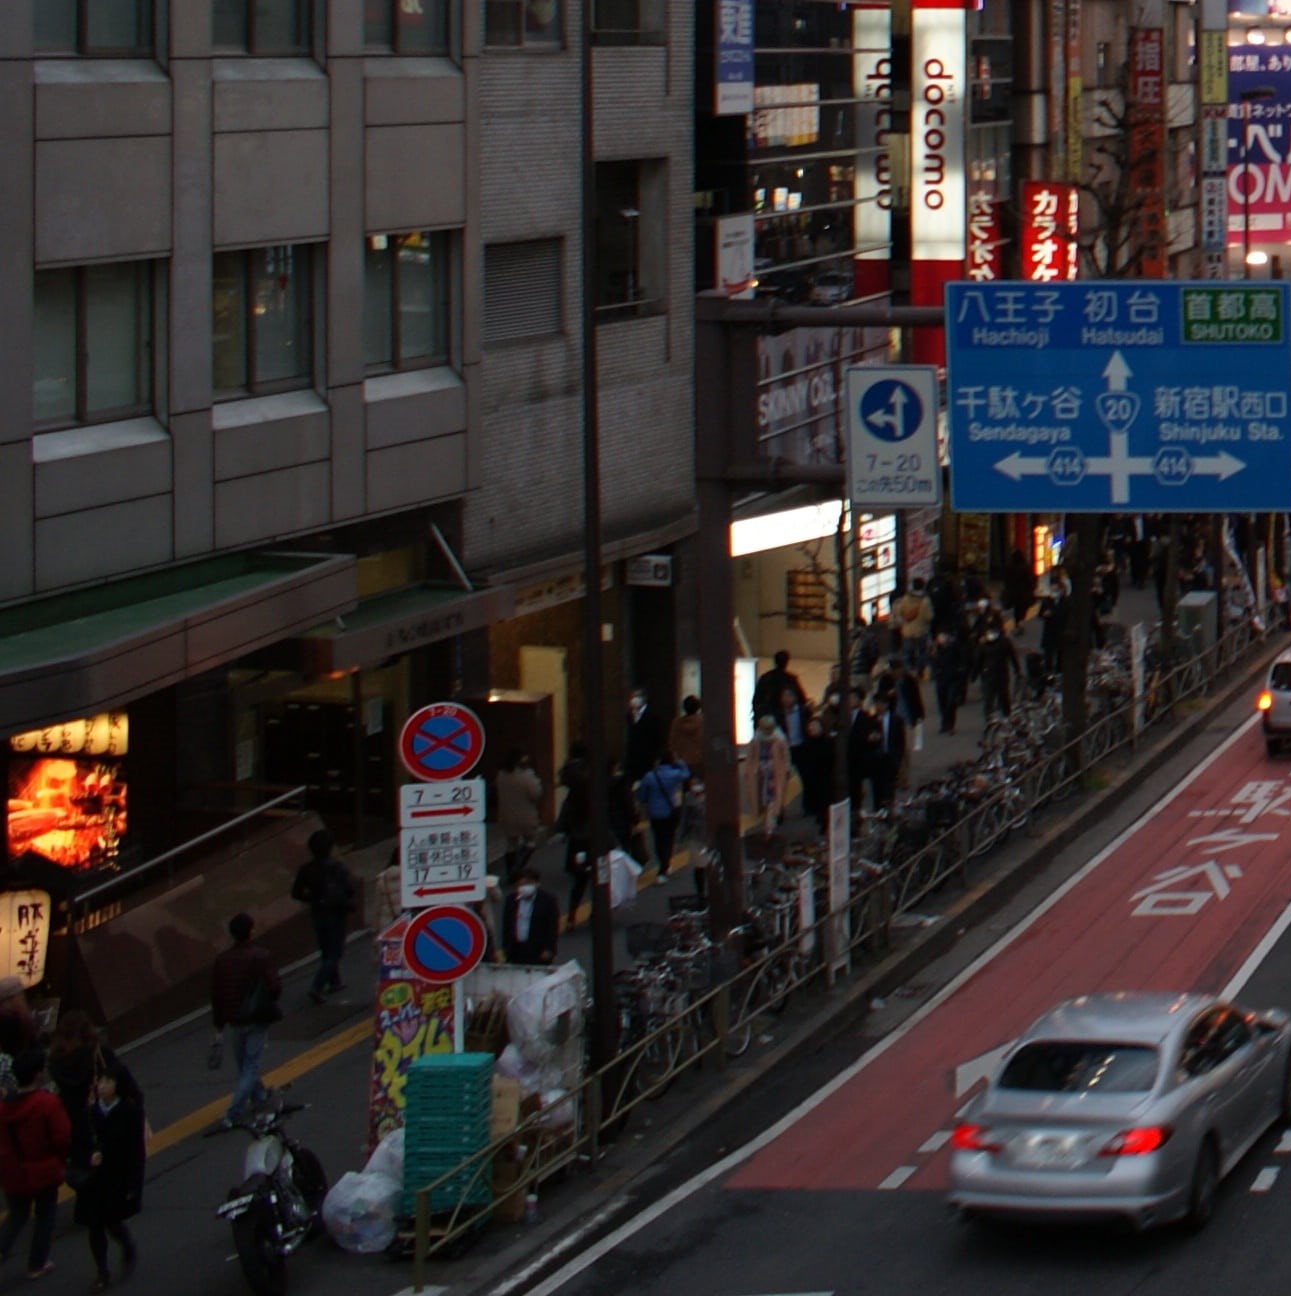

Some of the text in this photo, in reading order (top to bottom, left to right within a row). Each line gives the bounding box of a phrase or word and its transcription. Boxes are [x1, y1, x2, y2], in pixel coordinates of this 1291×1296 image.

[1135, 40, 1162, 104] 指圧
[923, 57, 953, 211] docomo
[1031, 189, 1058, 283] カラオケ
[956, 289, 1278, 324] 八王子 初台 首都高
[972, 323, 1274, 349] Hachioji Hatsudai SHUTOKO
[1105, 399, 1130, 421] 20
[1153, 385, 1287, 420] 新宿駅西口
[968, 421, 1285, 444] Sendagaya Shinjuku Sta.
[1052, 456, 1188, 475] 414 414
[855, 475, 933, 494] この先50m
